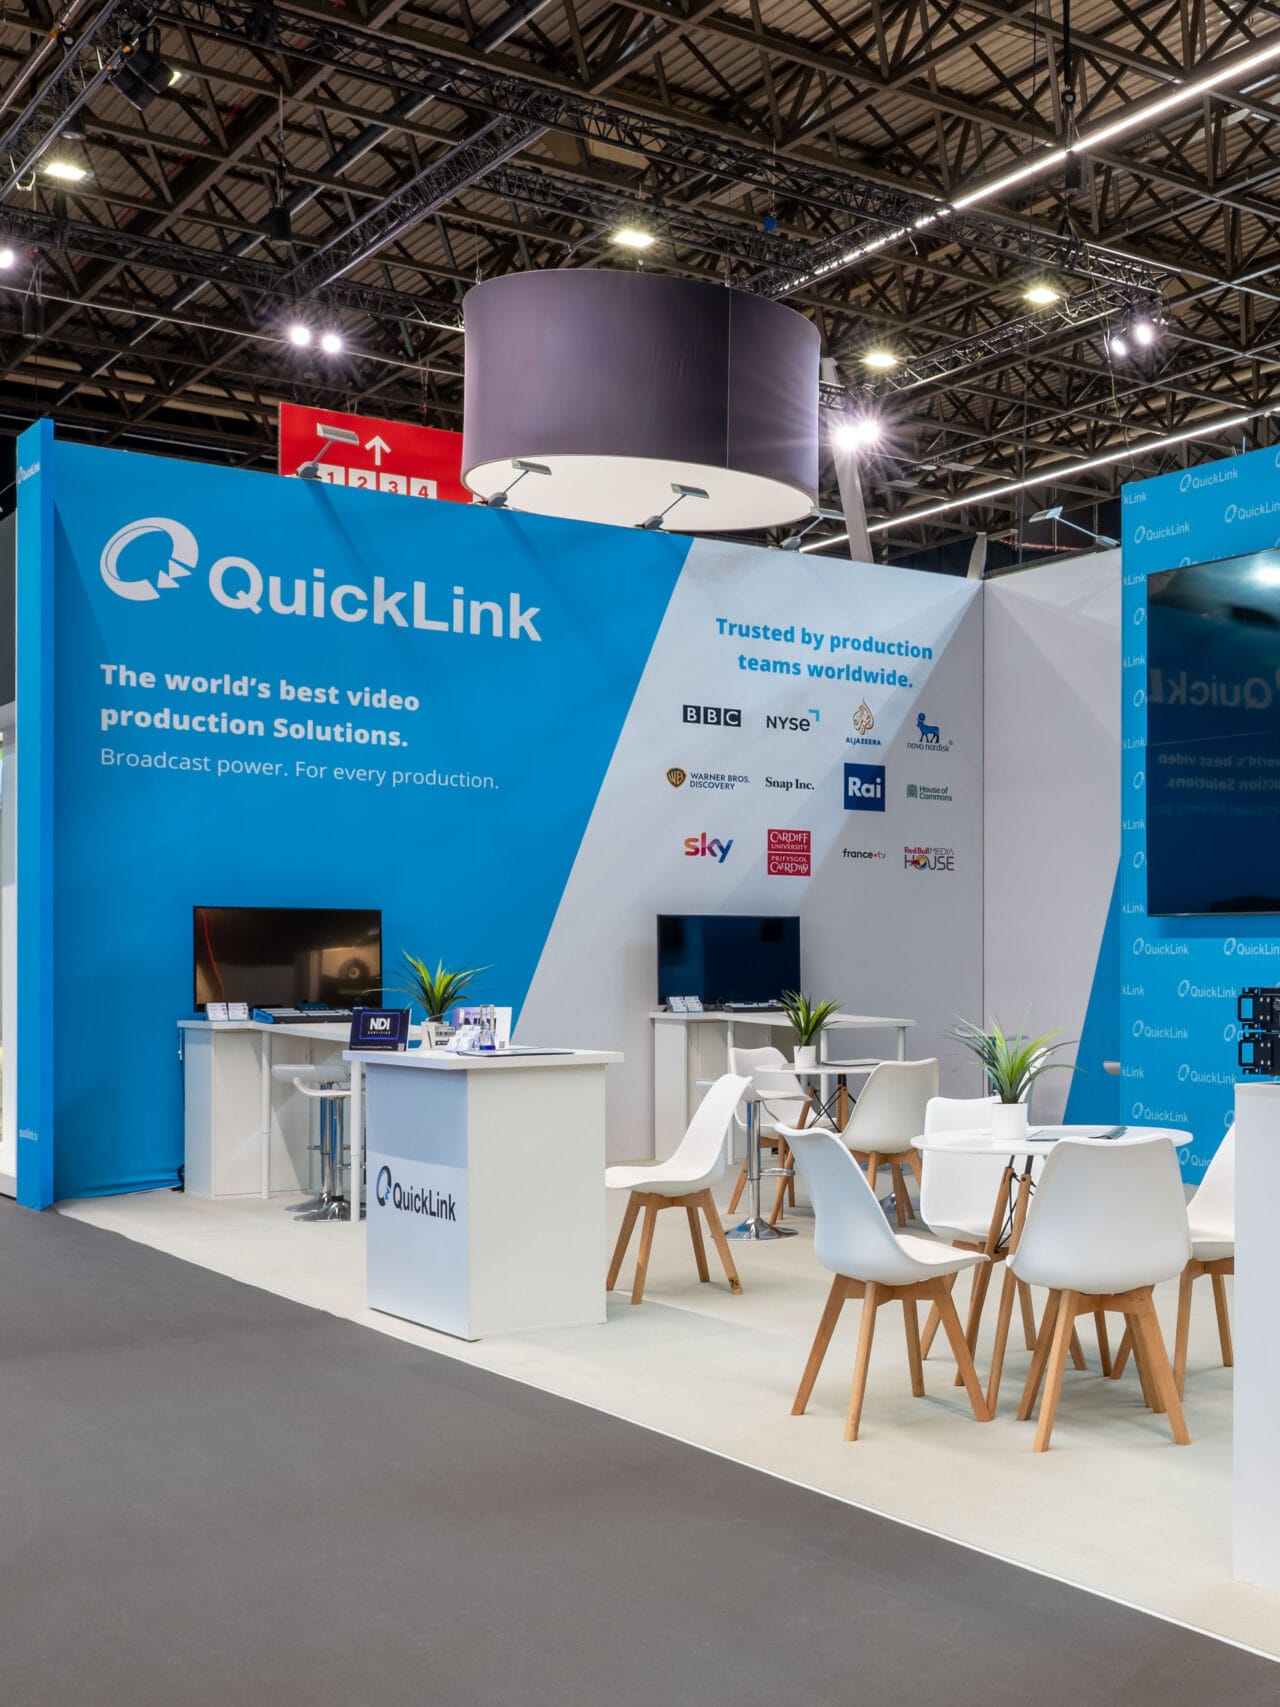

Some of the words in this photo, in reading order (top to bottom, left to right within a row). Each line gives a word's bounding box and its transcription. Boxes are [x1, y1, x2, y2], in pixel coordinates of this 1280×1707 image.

[1192, 467, 1238, 488] QuickLink
[418, 485, 429, 498] 4
[1143, 522, 1190, 541] QuickLink
[209, 557, 541, 641] QuickLink
[716, 617, 794, 643] Trusted
[801, 627, 824, 649] by
[830, 635, 933, 660] production
[738, 653, 801, 675] teams
[807, 661, 913, 688] worldwide.
[101, 664, 155, 688] The
[280, 680, 339, 704] best
[347, 687, 419, 711] video
[684, 705, 741, 727] BBC
[101, 708, 264, 736] production
[274, 718, 407, 747] Solutions.
[101, 748, 210, 771] Broadcast
[218, 760, 287, 776] power.
[296, 761, 327, 778] For
[334, 768, 386, 786] every
[393, 769, 498, 788] production.
[690, 772, 725, 781] WARNER
[728, 774, 750, 783] BROS.
[690, 780, 735, 790] DISCOVERY
[765, 777, 793, 791] Snap
[795, 779, 815, 790] Inc.
[848, 777, 881, 798] Rai
[920, 786, 940, 794] House
[769, 831, 809, 844] CARDIFF
[684, 832, 734, 863] sky
[771, 843, 808, 851] UNIVERSITY
[930, 847, 954, 855] MEDIA
[904, 854, 955, 871] HOUSE
[1141, 939, 1188, 955] QuickLink
[1190, 986, 1237, 998] QuickLink
[369, 1018, 390, 1030] NDI
[1142, 1024, 1188, 1038] QuickLink
[1190, 1070, 1237, 1085] QuickLink
[1142, 1106, 1188, 1123] QuickLink
[393, 1182, 456, 1221] QuickLink
